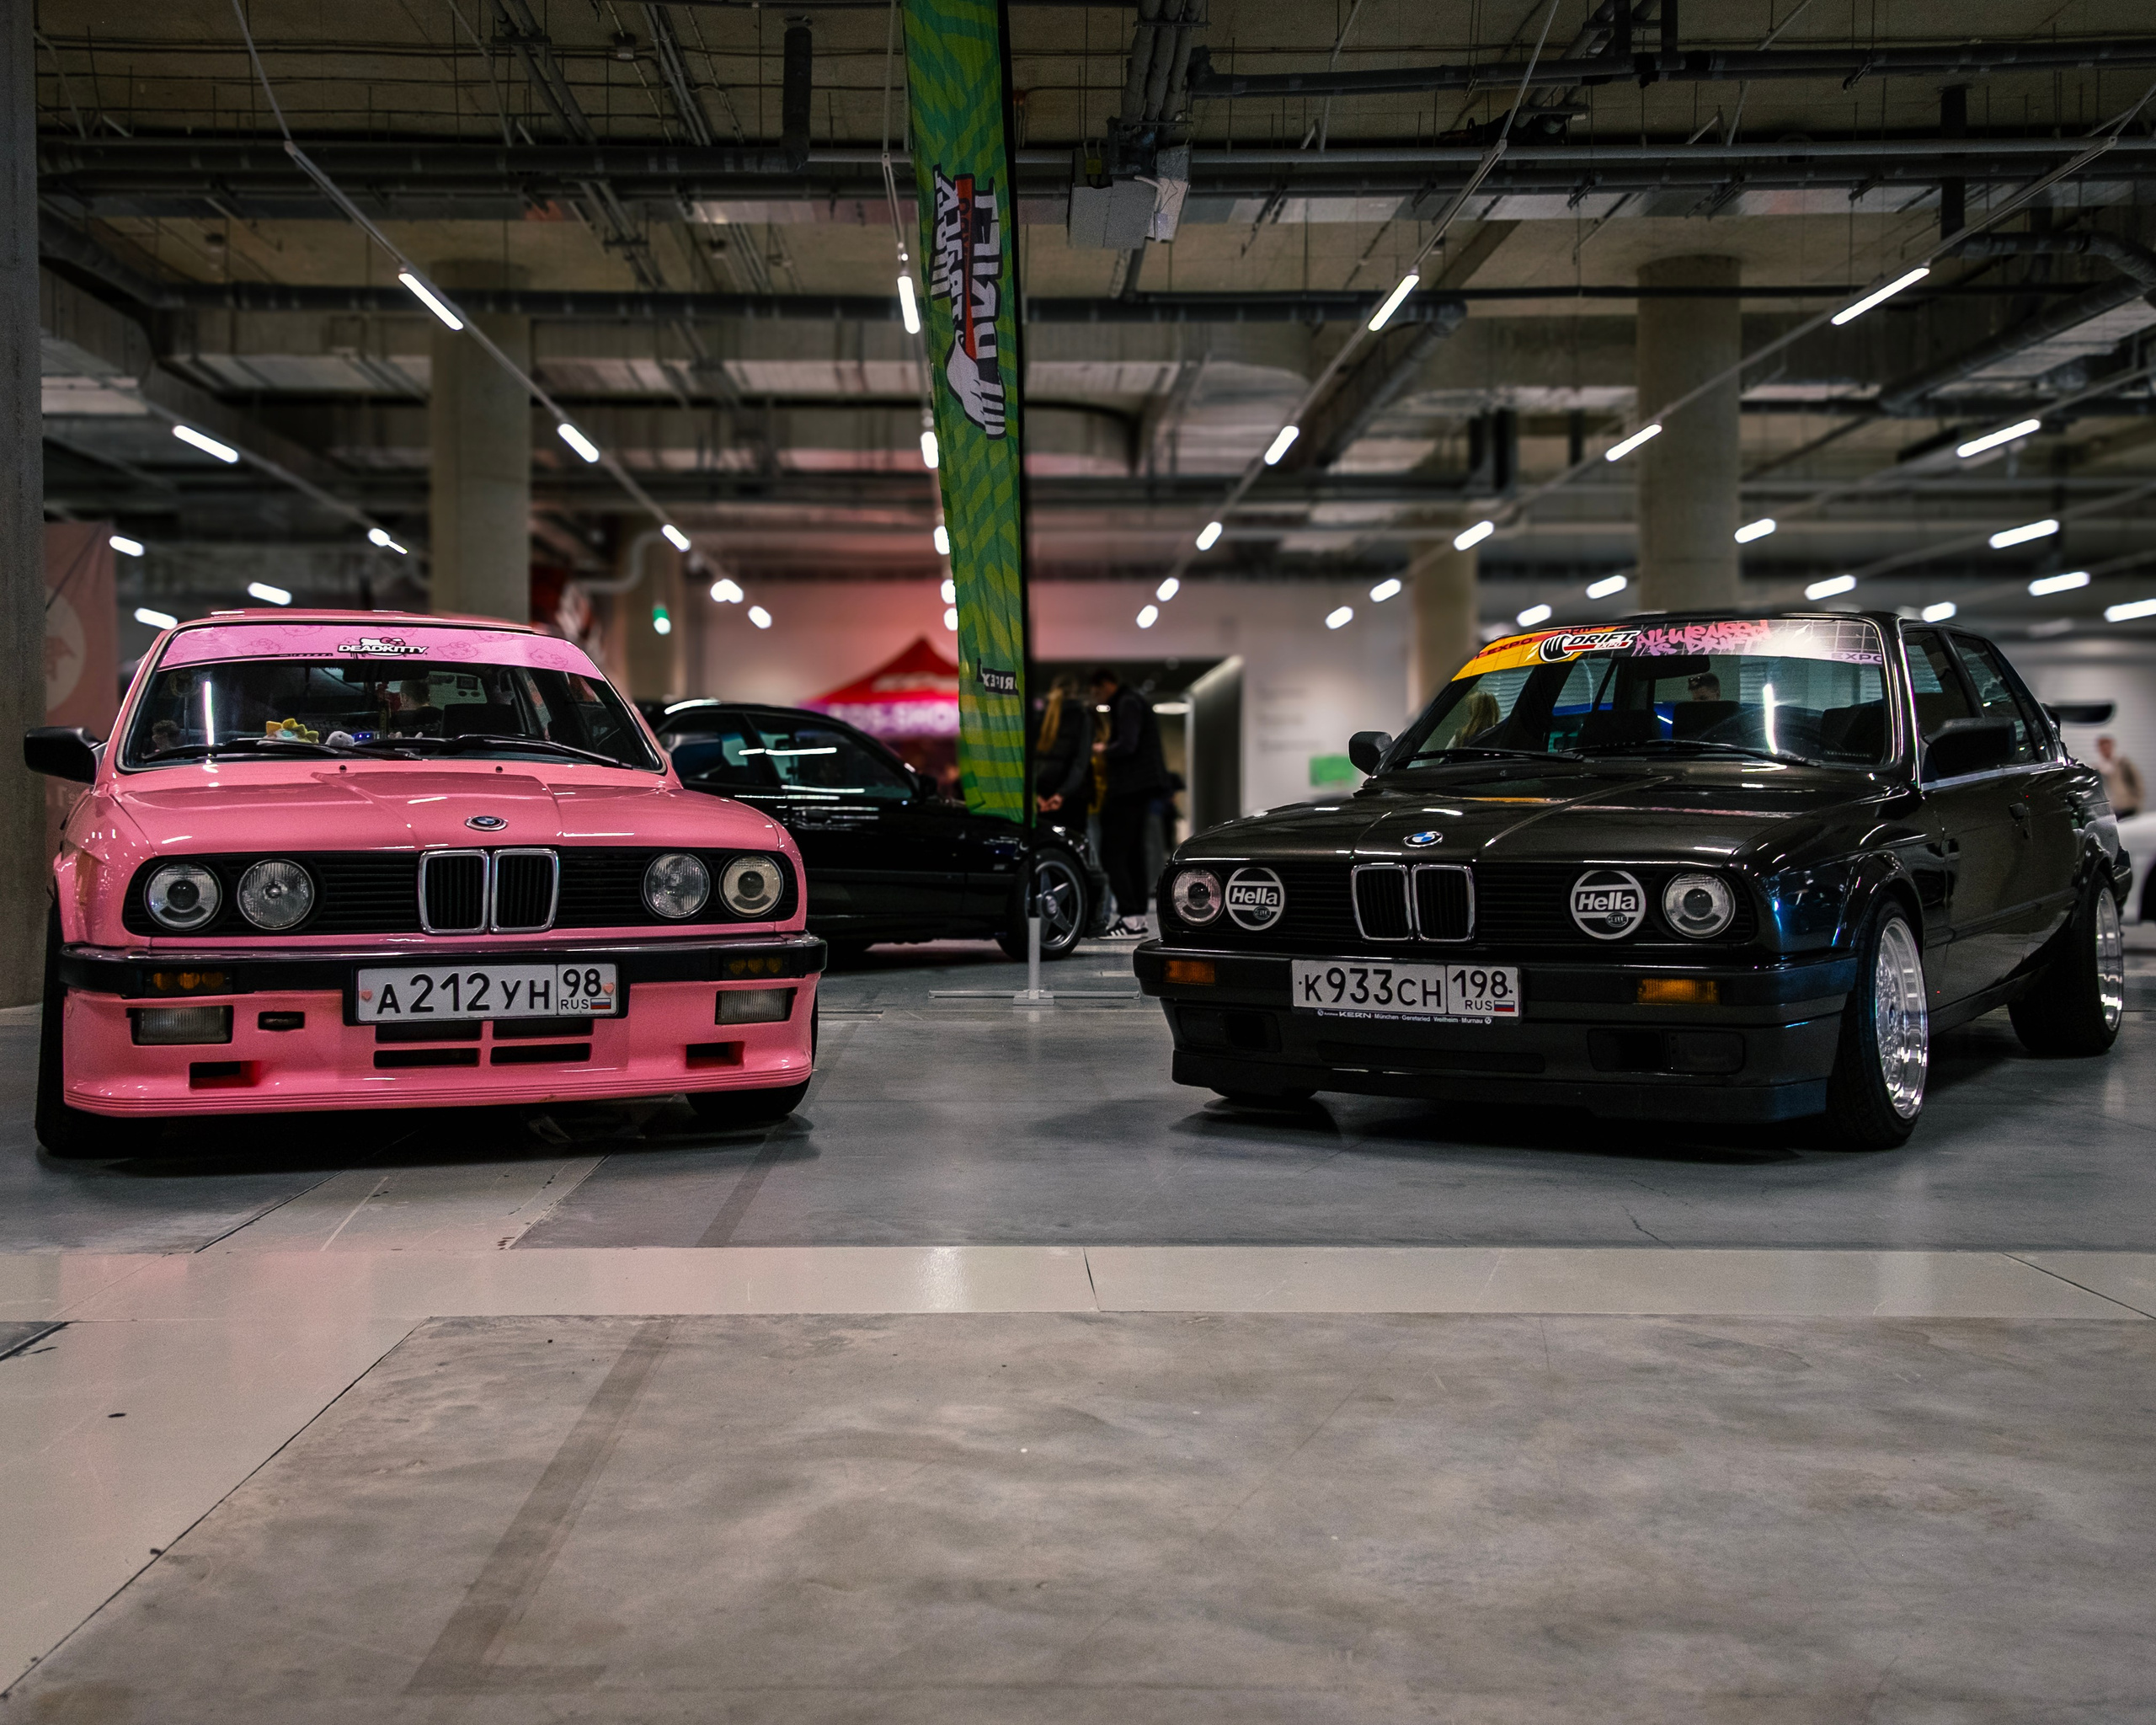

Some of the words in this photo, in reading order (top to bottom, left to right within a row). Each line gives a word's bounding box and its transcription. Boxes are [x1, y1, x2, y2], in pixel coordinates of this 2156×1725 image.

[1486, 638, 1533, 655] EXPO
[1568, 633, 1638, 645] DRIFT
[338, 644, 430, 654] DEADKITTY
[1230, 887, 1278, 905] Hella
[1577, 891, 1636, 911] Hella
[562, 968, 602, 998] 98
[1451, 969, 1508, 999] 198
[560, 998, 589, 1011] RUS
[1465, 999, 1493, 1011] RUS
[1338, 1011, 1372, 1019] KERN
